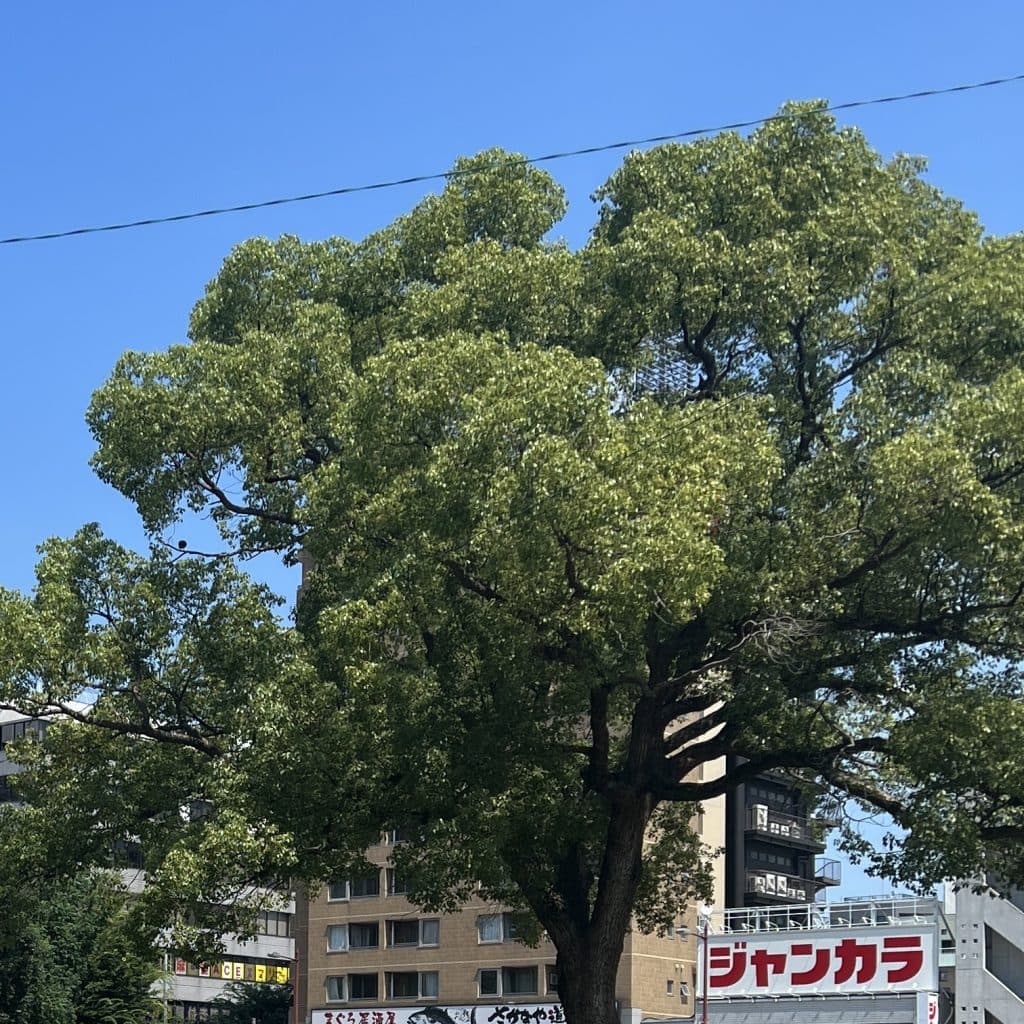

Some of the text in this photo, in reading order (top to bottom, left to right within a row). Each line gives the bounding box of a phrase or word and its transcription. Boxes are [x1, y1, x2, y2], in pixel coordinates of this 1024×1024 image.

[709, 936, 924, 988] ジャンカラ
